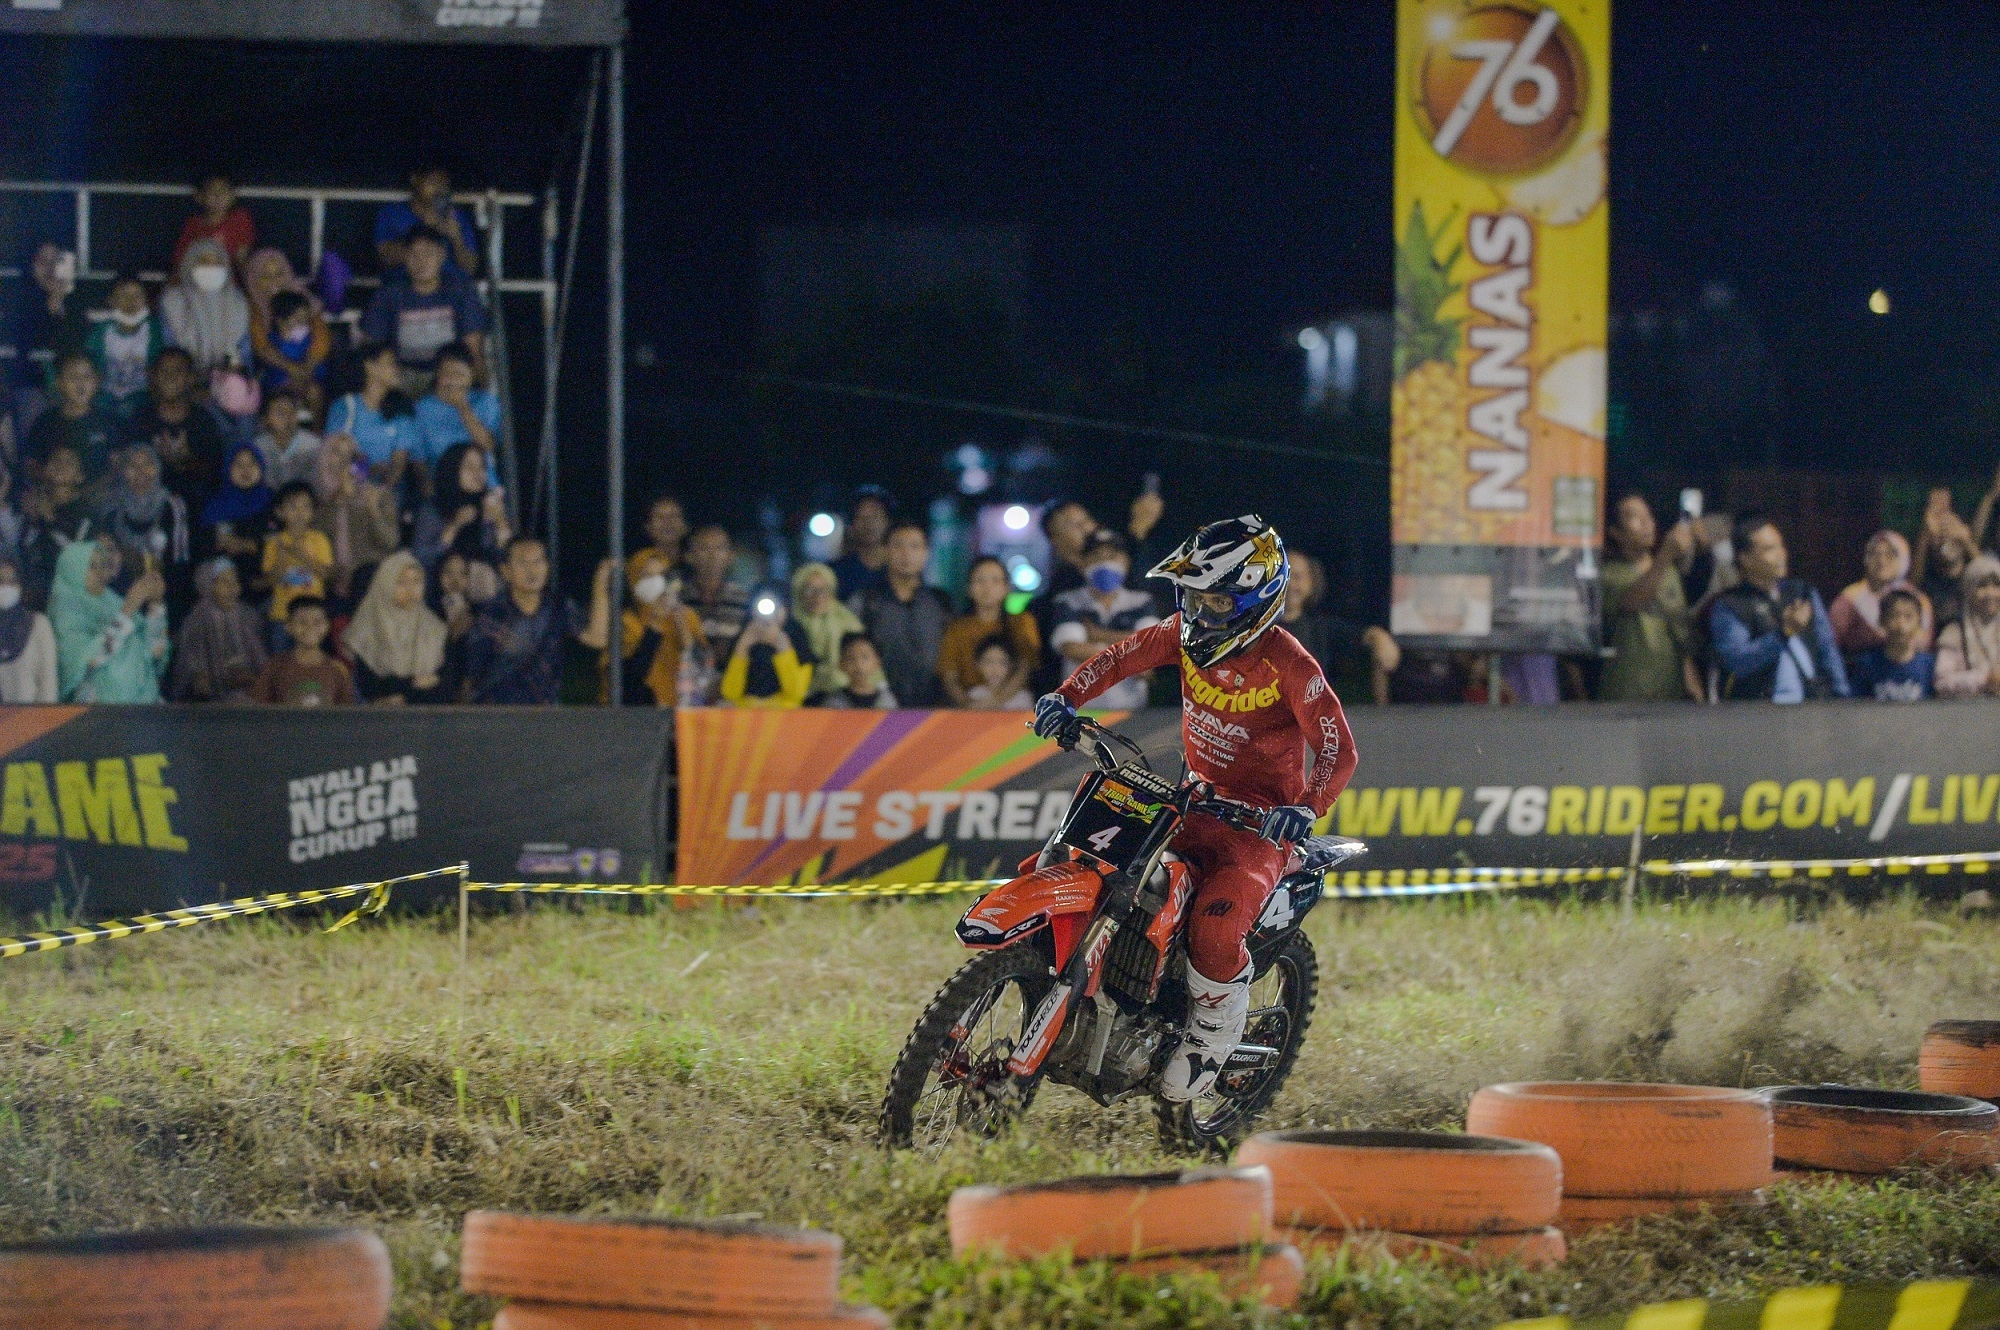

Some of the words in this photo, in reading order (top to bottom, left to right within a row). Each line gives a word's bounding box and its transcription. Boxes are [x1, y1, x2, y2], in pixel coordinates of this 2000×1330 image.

[1432, 9, 1560, 157] 76
[1468, 211, 1534, 510] NANAS
[288, 765, 365, 801] NYALI
[369, 755, 418, 782] AJA
[1196, 749, 1228, 769] SWALLOW
[0, 753, 189, 853] AME
[288, 777, 418, 837] NGGA
[727, 791, 862, 841] LIVE
[1126, 799, 1149, 815] GAME
[1313, 773, 2000, 841] WW.76RIDER.COM/LIV
[288, 821, 386, 863] CUKUP
[1087, 825, 1122, 852] 4
[1260, 889, 1295, 931] 4
[1016, 991, 1060, 1054] TOUGHRIDER
